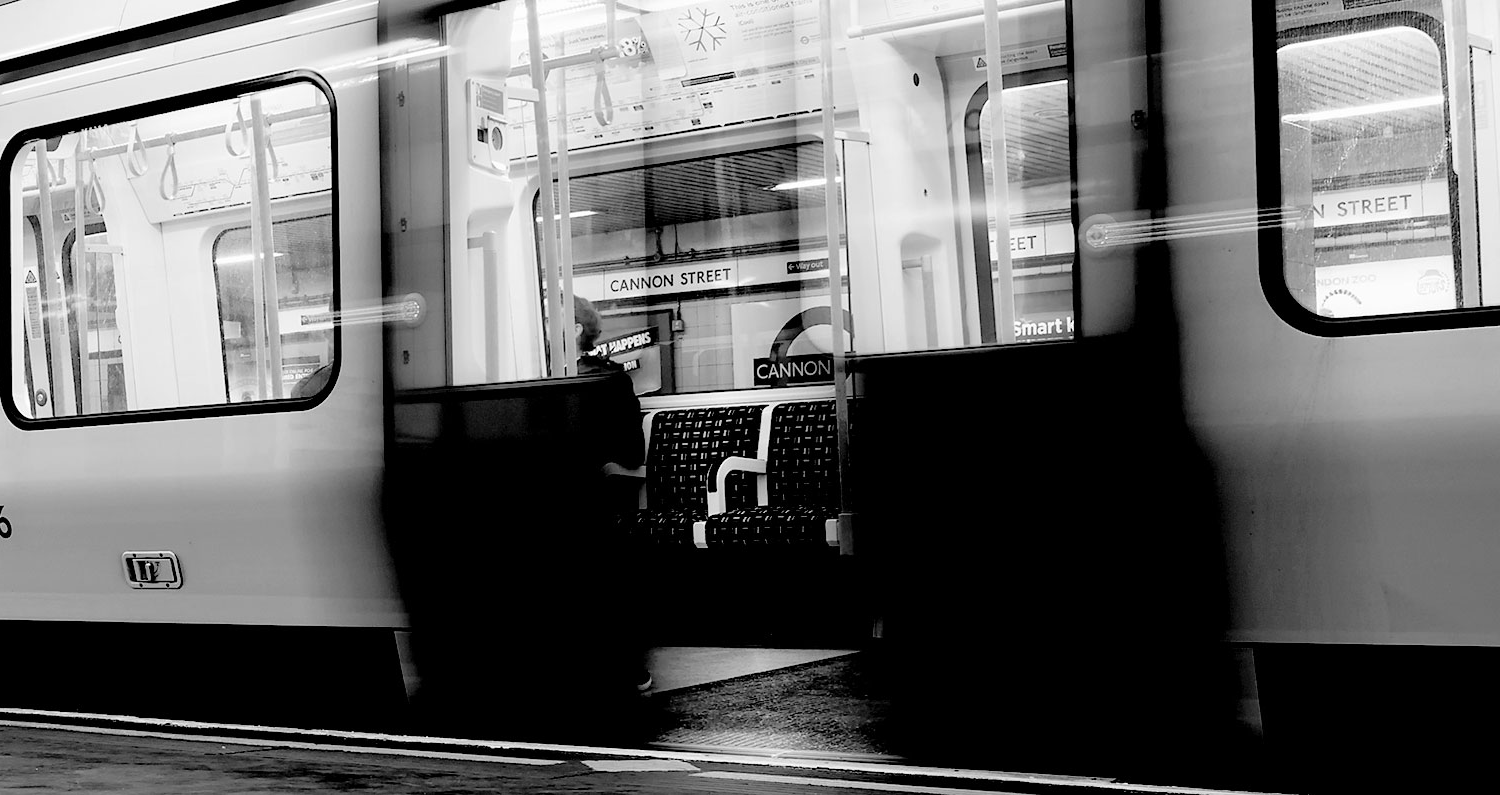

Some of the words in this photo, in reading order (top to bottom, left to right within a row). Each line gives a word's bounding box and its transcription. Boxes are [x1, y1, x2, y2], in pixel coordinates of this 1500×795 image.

[1337, 194, 1412, 217] STREET
[810, 261, 825, 269] out
[610, 274, 674, 292] CANNON
[680, 267, 732, 286] STREET
[608, 331, 652, 354] HAPPENS
[756, 359, 831, 380] CANNON
